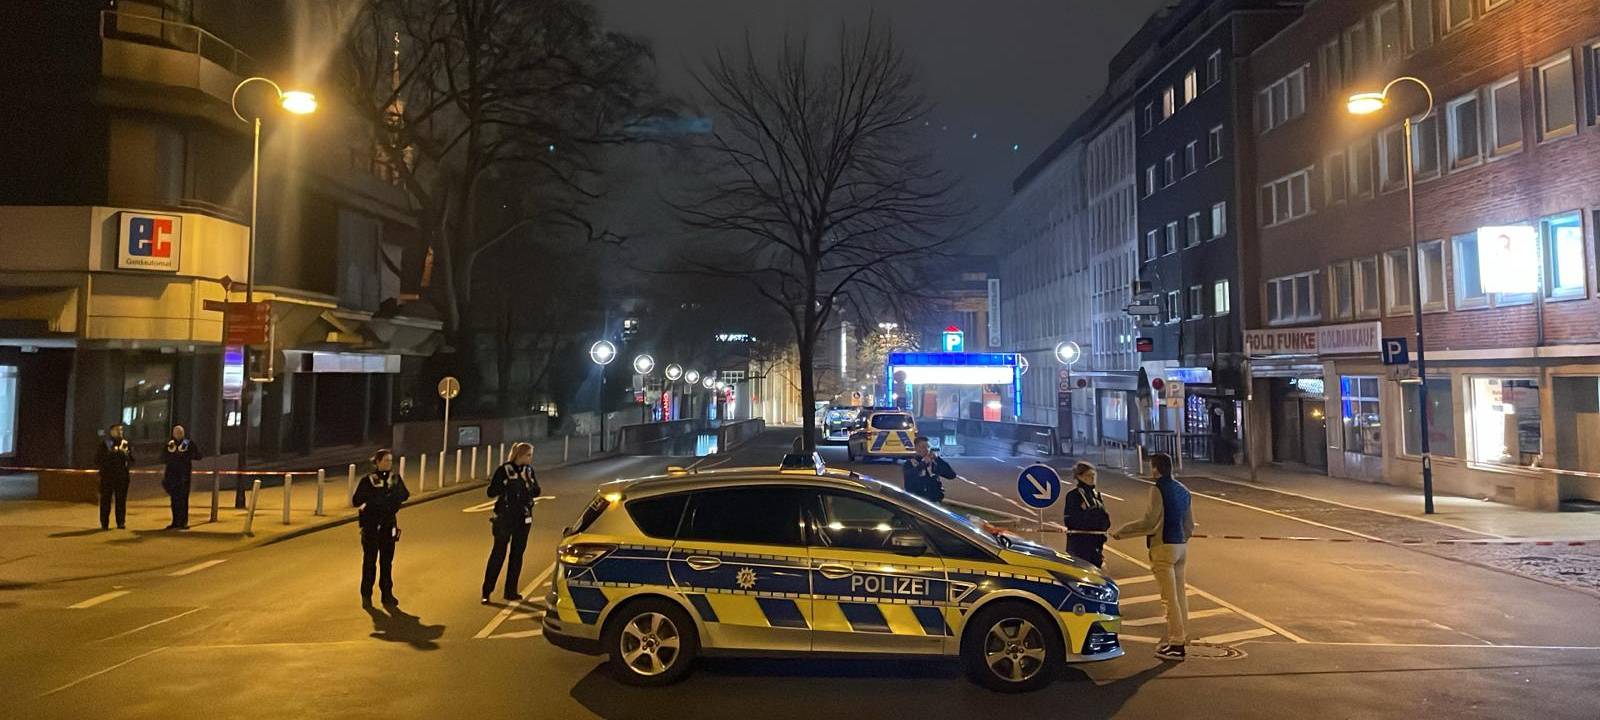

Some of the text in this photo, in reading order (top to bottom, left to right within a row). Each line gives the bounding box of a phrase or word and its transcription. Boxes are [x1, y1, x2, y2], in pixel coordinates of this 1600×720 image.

[946, 334, 961, 351] P
[1246, 332, 1315, 350] GOLD FUNKE
[1388, 341, 1402, 363] P
[1170, 384, 1180, 397] P
[851, 575, 929, 596] POLIZEI
